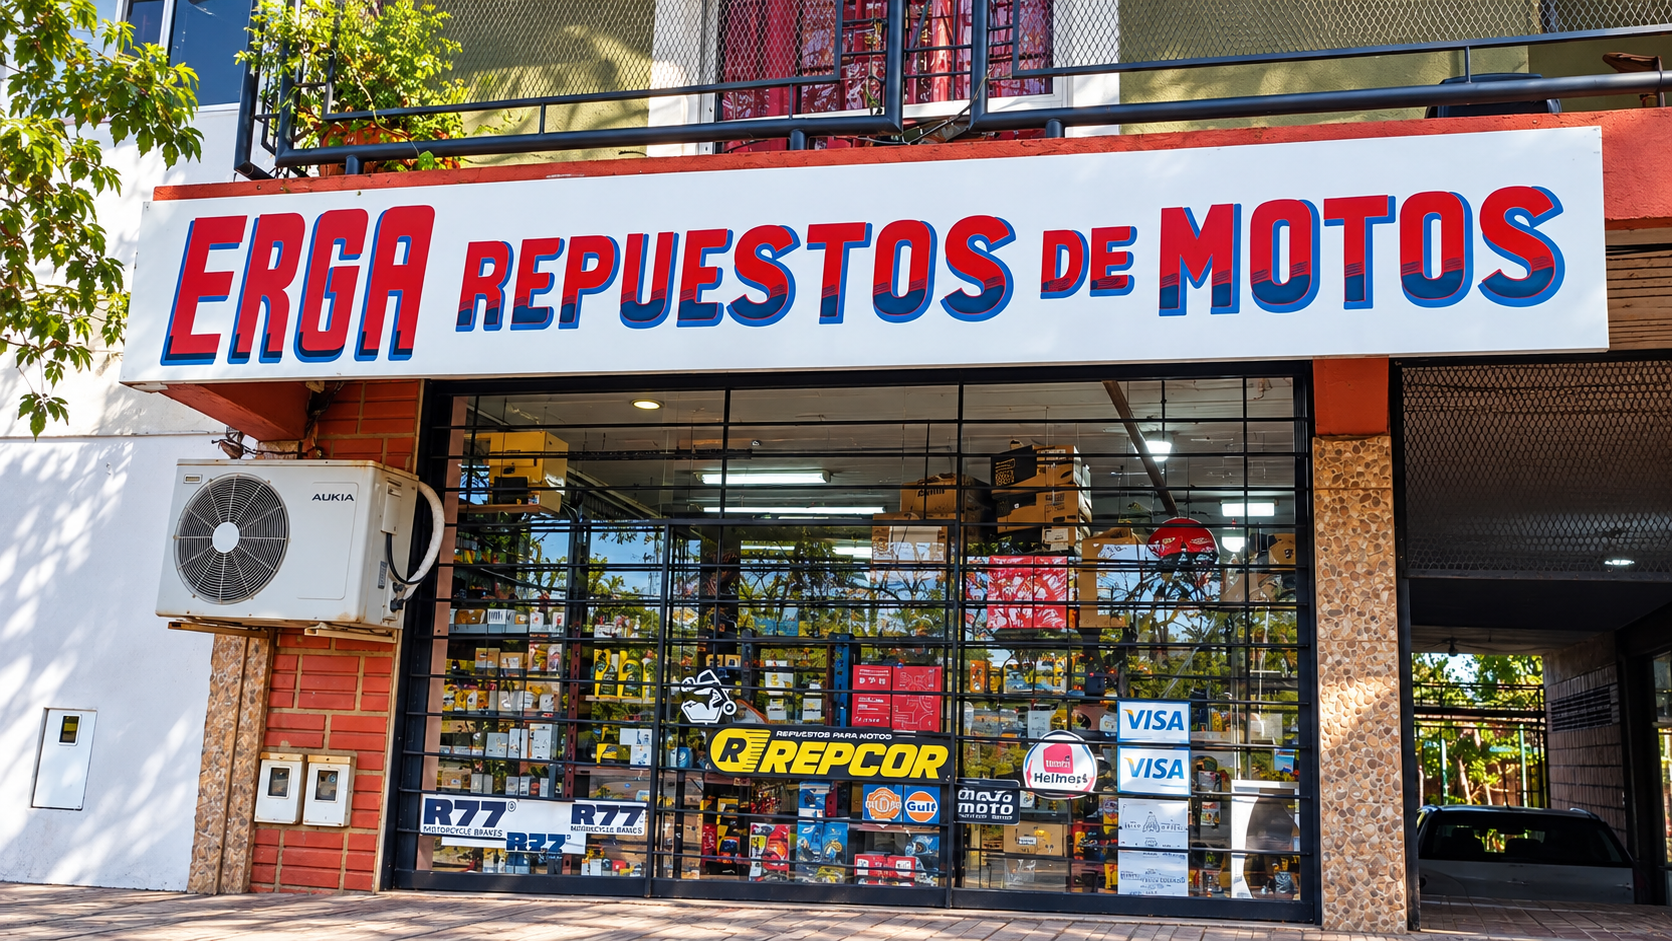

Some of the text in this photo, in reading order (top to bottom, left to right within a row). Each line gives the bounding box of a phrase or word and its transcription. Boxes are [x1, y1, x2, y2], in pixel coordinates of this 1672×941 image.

[160, 186, 1565, 366] ERGA REPUESTOS DE MOTOS
[312, 493, 354, 501] AUKIA
[1123, 709, 1184, 731] VISA
[758, 740, 949, 779] REPCOR
[1124, 757, 1184, 779] VISA
[424, 798, 507, 828] R77
[571, 803, 643, 826] R77
[958, 803, 1014, 815] moto
